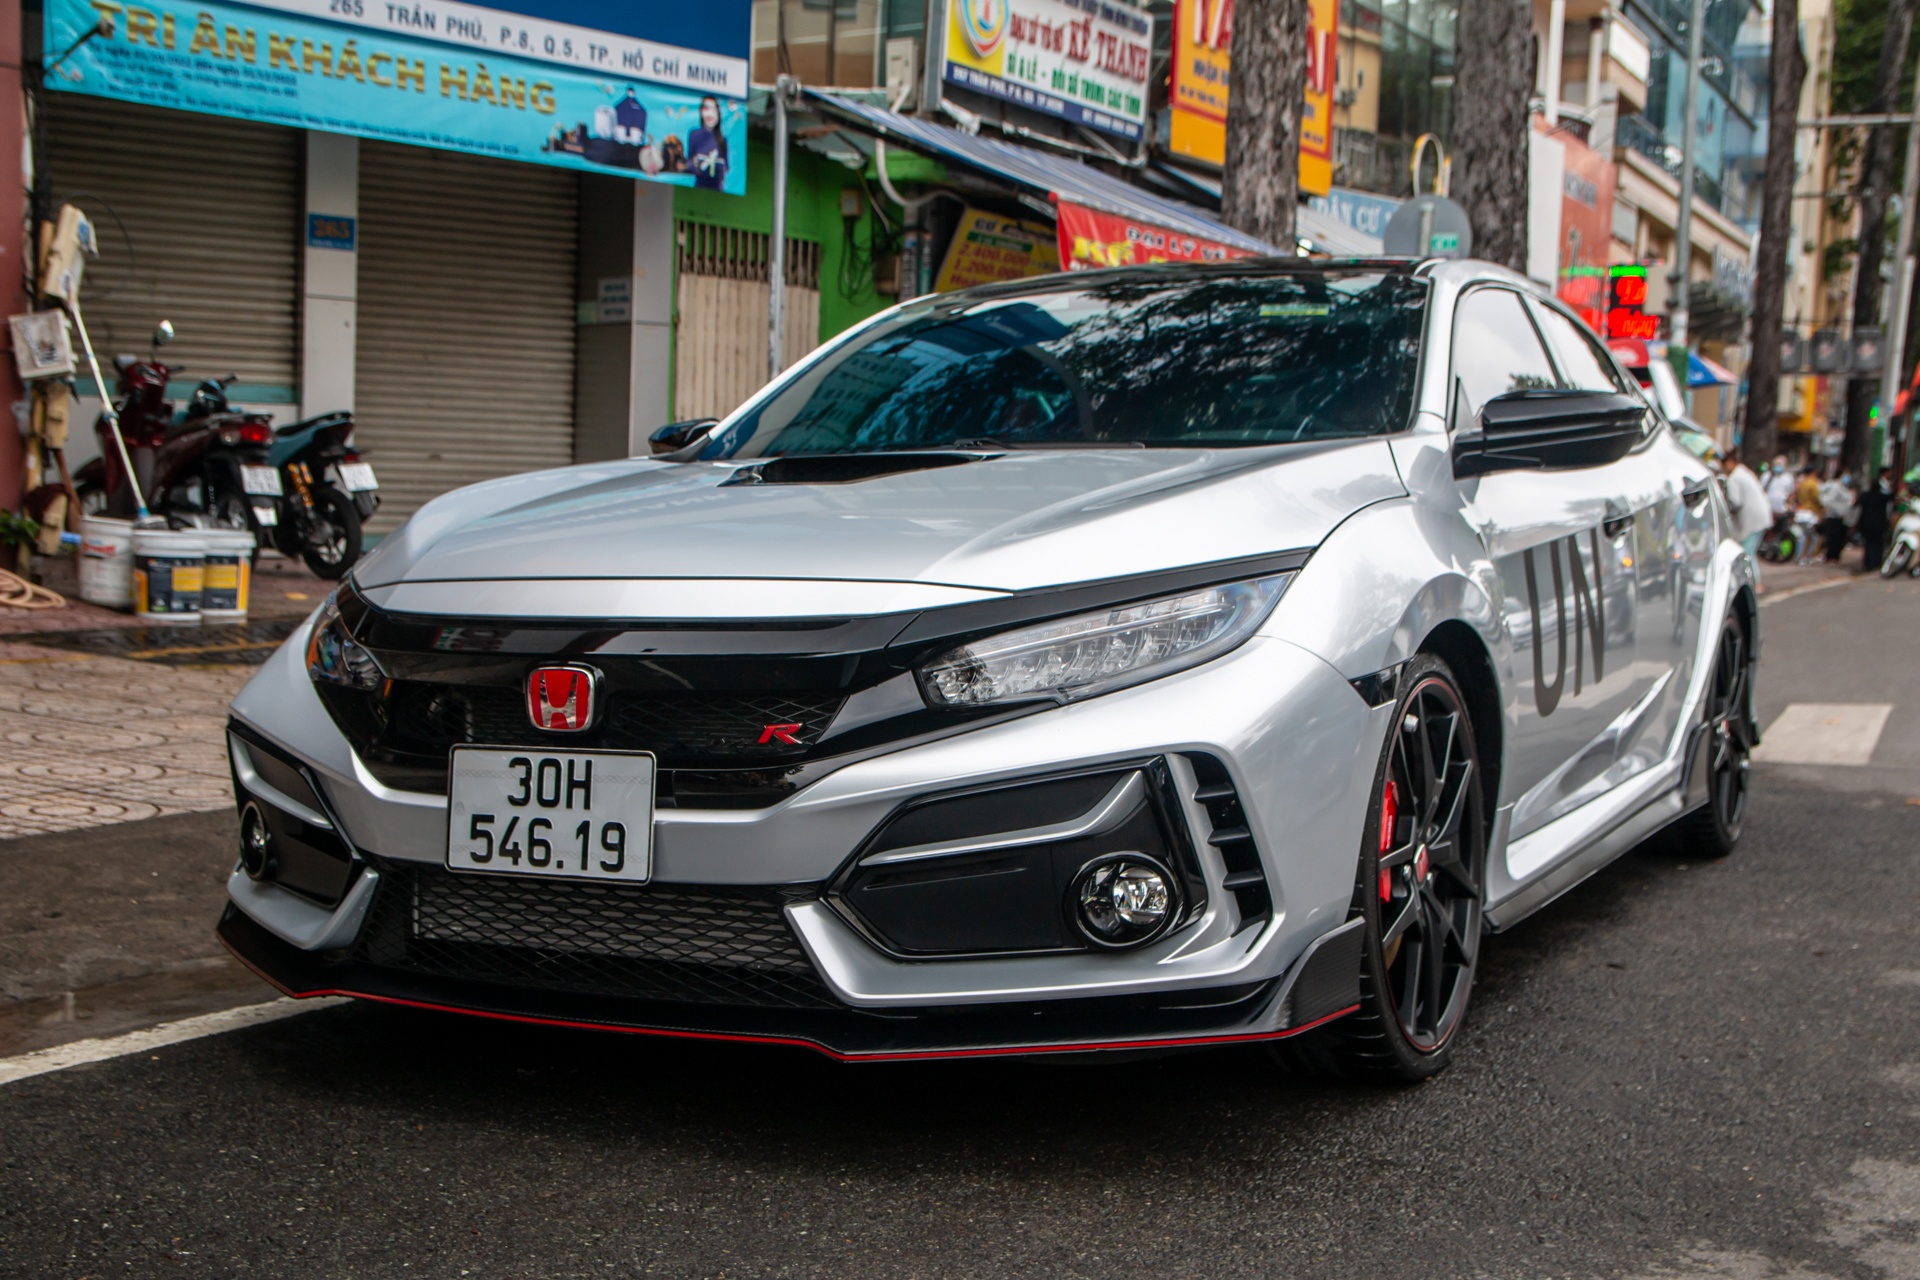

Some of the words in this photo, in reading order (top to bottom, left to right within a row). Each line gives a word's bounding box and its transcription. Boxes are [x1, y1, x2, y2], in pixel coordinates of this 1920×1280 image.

[91, 0, 176, 50] TRI
[189, 12, 257, 65] ÂN
[268, 30, 426, 94] KHÁCH
[439, 62, 557, 115] HÀNG
[385, 3, 436, 31] TRẦN
[652, 58, 681, 80] CHÍ
[686, 62, 728, 87] MINH
[1095, 30, 1148, 83] THANH
[757, 722, 803, 745] R
[507, 756, 593, 811] 30H
[469, 813, 628, 873] 546.19
